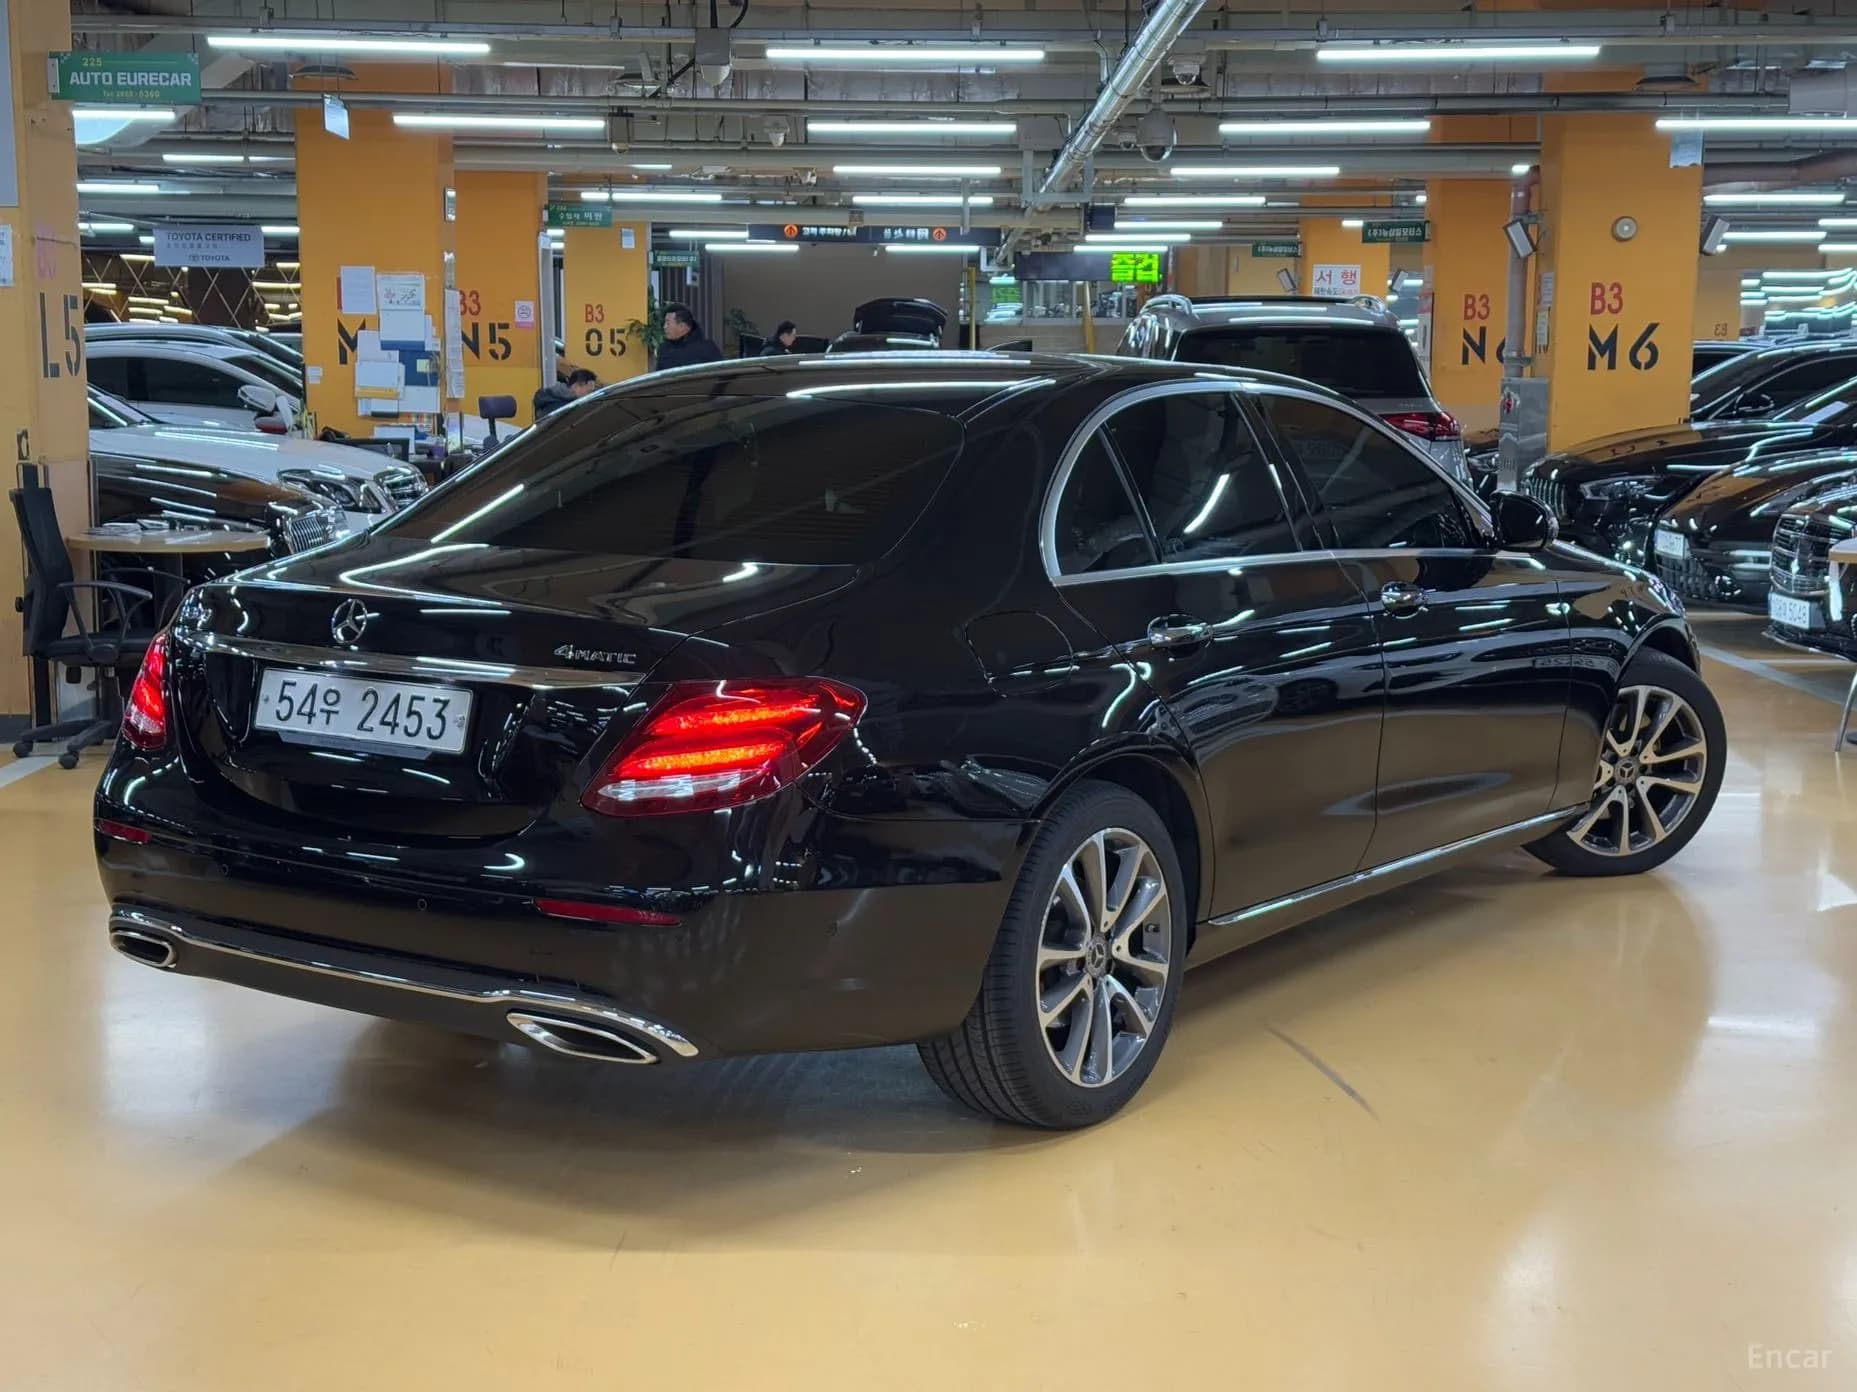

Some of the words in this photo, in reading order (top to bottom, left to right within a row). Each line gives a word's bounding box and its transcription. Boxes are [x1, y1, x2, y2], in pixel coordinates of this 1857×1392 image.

[81, 57, 103, 67] 225
[69, 71, 113, 86] AUTO
[116, 71, 192, 87] EURECAR
[166, 232, 203, 241] TOYOTA
[204, 232, 251, 242] CERTIFIED
[200, 254, 231, 262] TOYOTA
[1463, 293, 1491, 320] B3
[1589, 281, 1624, 316] B3
[585, 303, 604, 323] B3
[1587, 321, 1660, 371] M6
[553, 643, 637, 665] 4MATIC
[274, 679, 342, 726] 54우
[356, 686, 450, 741] 2453
